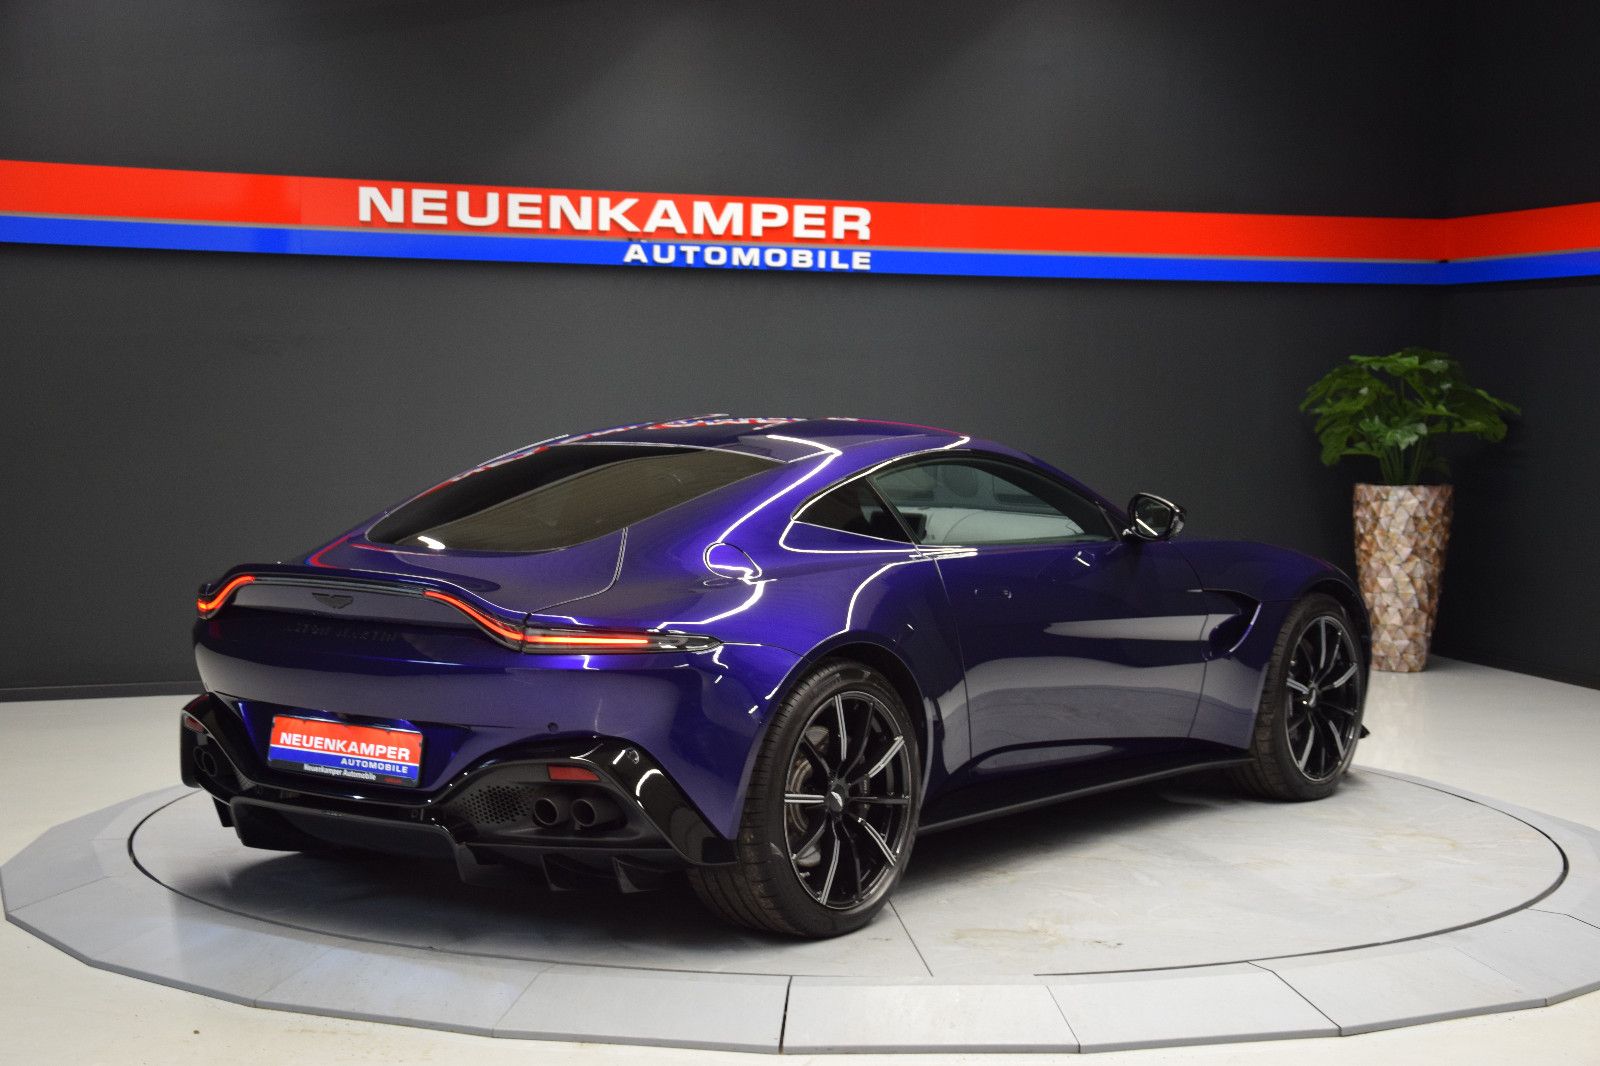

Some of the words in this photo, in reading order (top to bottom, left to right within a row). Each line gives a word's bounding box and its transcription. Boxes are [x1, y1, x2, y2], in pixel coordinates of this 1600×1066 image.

[358, 186, 872, 241] NEUENKAMPER
[623, 243, 872, 270] AUTOMOBILE
[279, 732, 411, 761] NEUENKAMPER
[303, 763, 343, 776] Neuenkamper
[343, 769, 377, 781] Automobile
[340, 757, 409, 774] AUTOMOBILE
